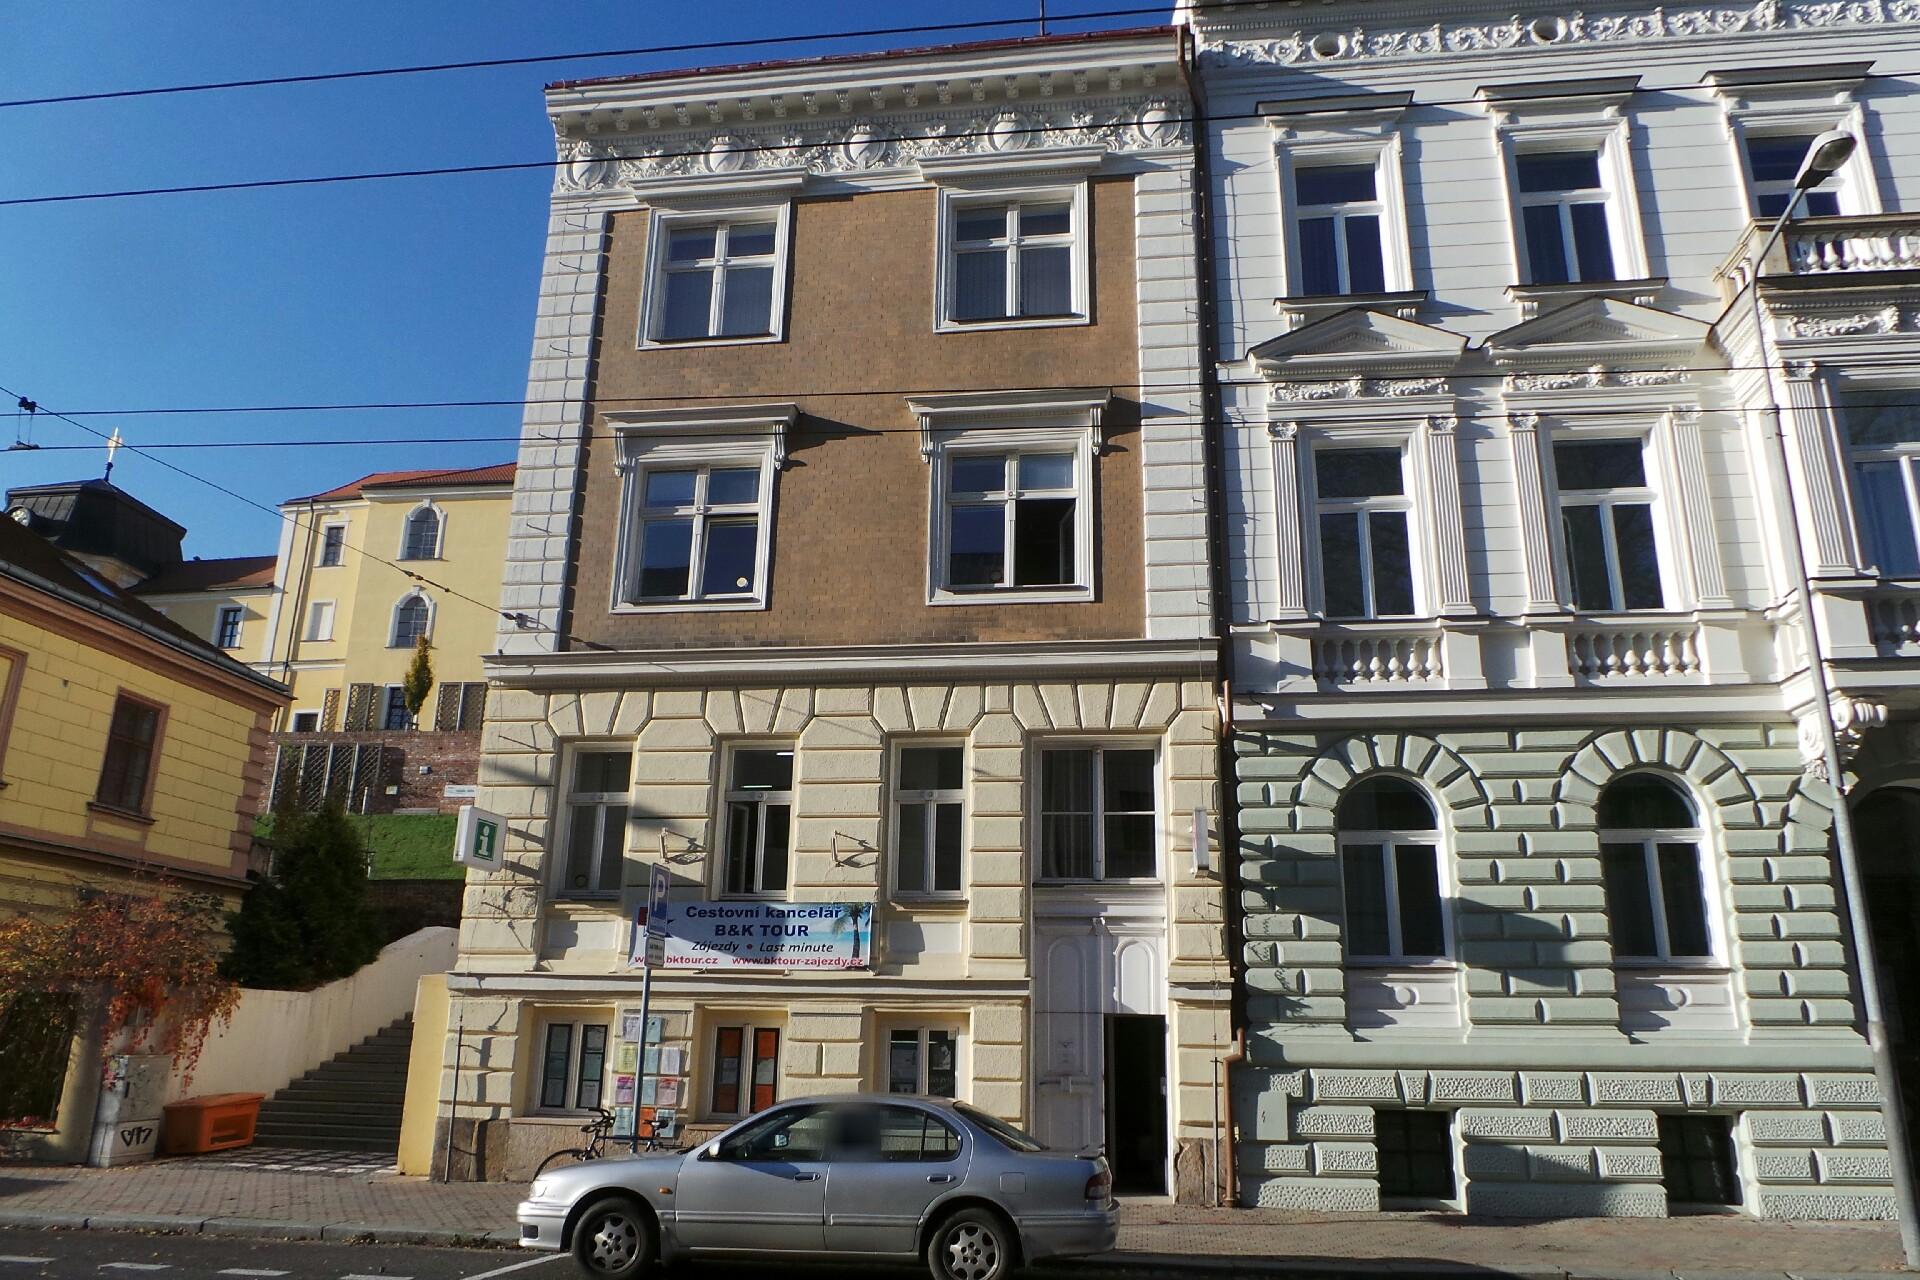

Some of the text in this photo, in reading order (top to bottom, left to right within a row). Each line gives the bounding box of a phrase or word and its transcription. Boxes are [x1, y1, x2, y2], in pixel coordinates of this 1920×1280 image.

[654, 873, 666, 912] P
[686, 906, 842, 919] Cestovní kancelář
[715, 924, 809, 937] B&K TOUR
[691, 941, 834, 953] Zájezdy Last minute
[634, 955, 719, 965] w.bktour.cz
[732, 956, 864, 968] www.bktour-zajezdy.cz
